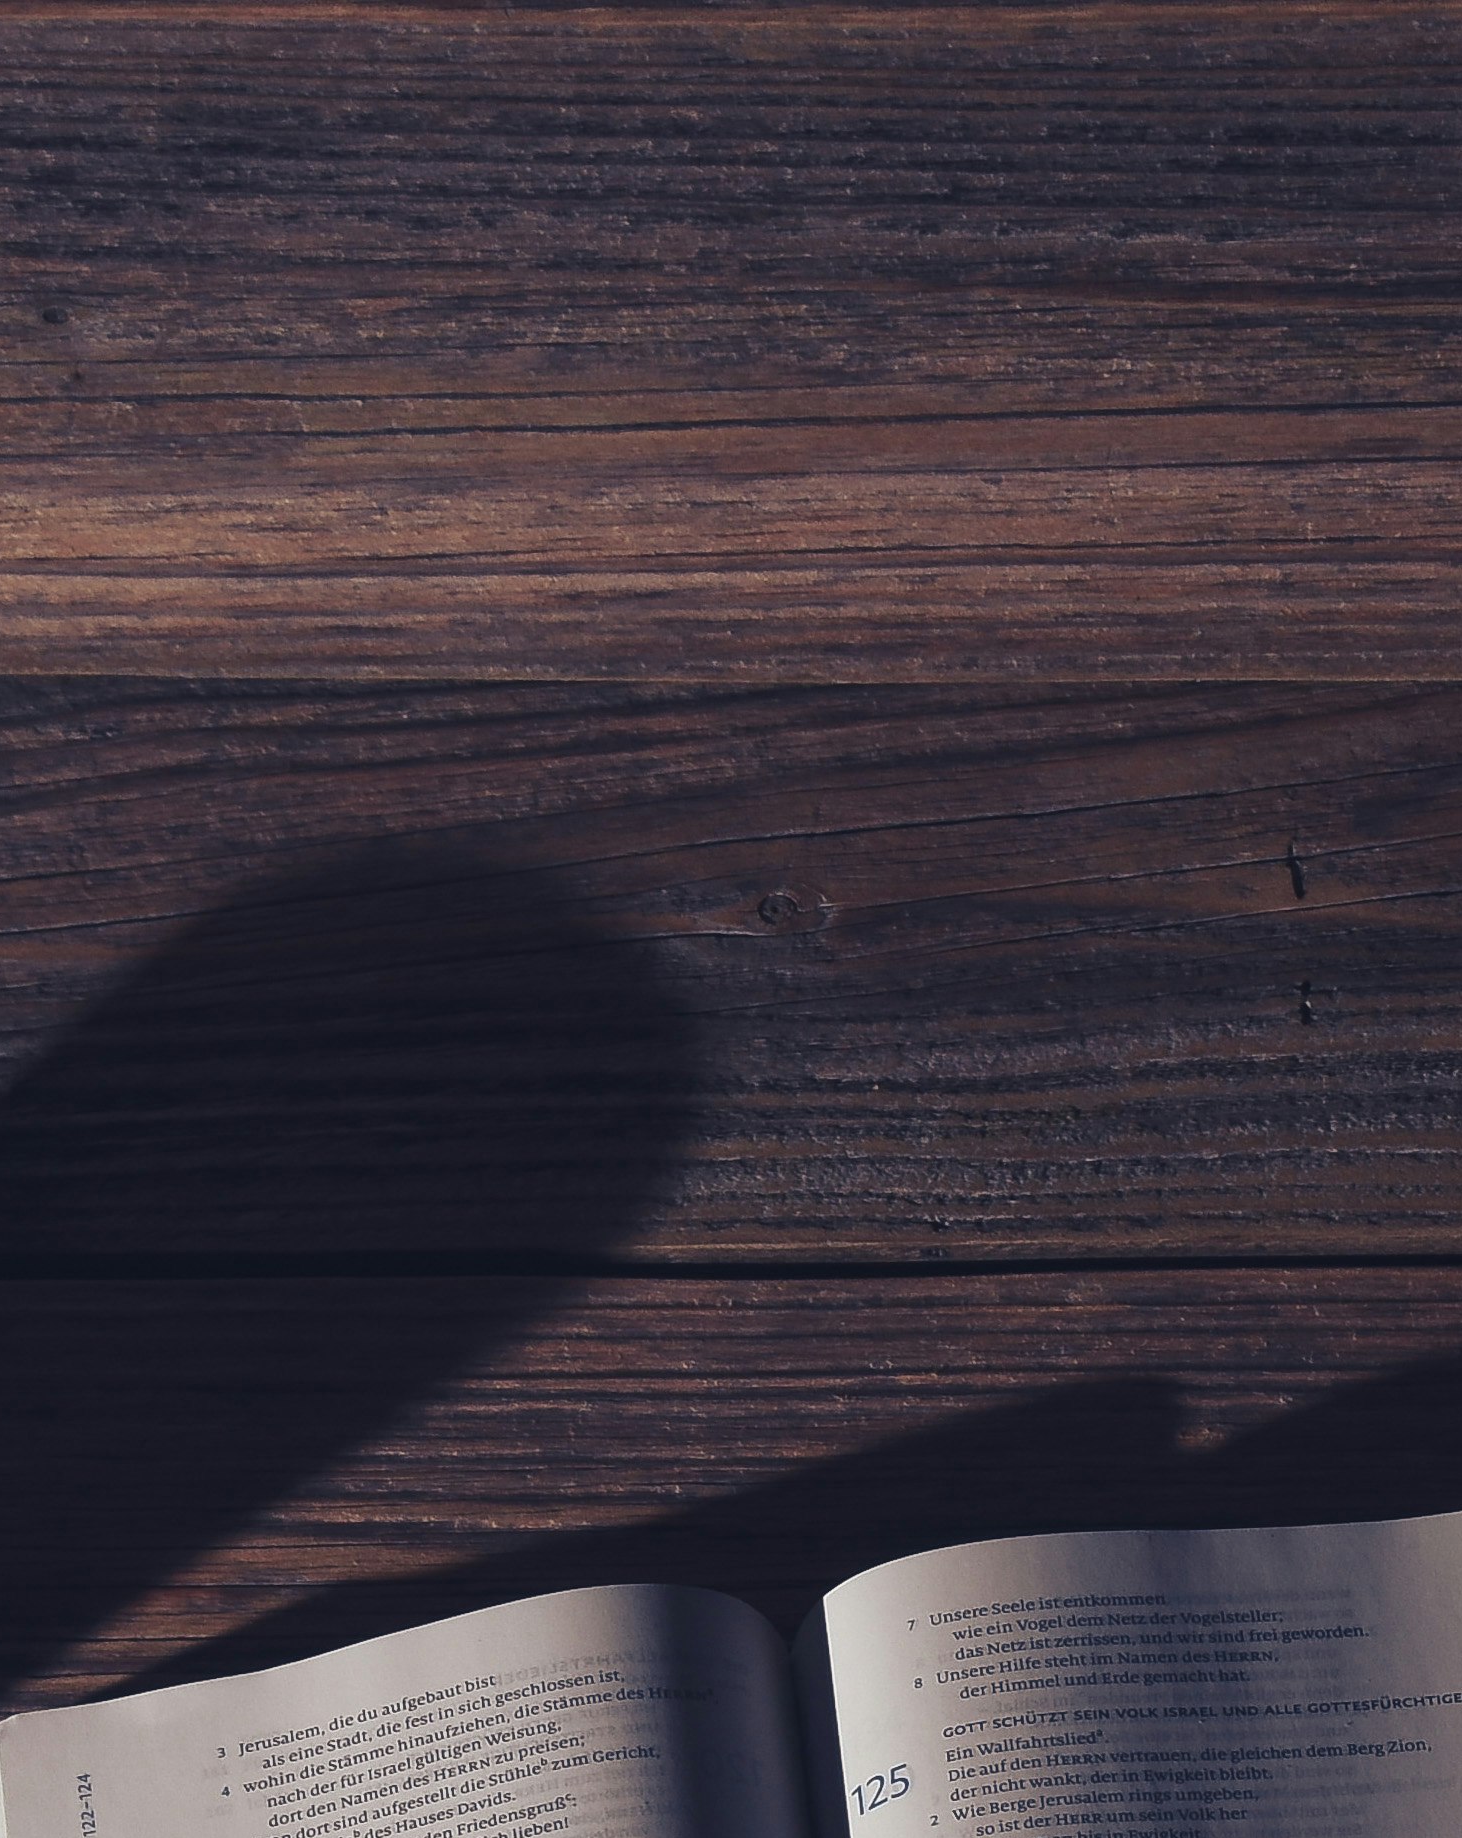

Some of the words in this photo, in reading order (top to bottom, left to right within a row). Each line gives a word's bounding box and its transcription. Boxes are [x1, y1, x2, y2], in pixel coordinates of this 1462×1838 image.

[950, 1623, 985, 1642] wie
[985, 1619, 1015, 1637] ein
[1014, 1613, 1067, 1634] Vogel
[1063, 1612, 1107, 1629] dem
[1105, 1612, 1150, 1627] Netz
[1147, 1611, 1178, 1626] der
[913, 1676, 924, 1690] 8
[935, 1664, 998, 1685] Unsere
[996, 1655, 1043, 1675] Hilfe
[1043, 1652, 1089, 1670] steht
[1089, 1651, 1115, 1667] im
[1115, 1650, 1180, 1666] Namen
[1180, 1649, 1212, 1665] des
[215, 1746, 227, 1760] 3
[237, 1725, 327, 1759] Jerusalem,
[328, 1714, 355, 1733] die
[355, 1708, 379, 1724] du
[380, 1683, 463, 1717] aufgebaut
[463, 1674, 498, 1694] bist
[261, 1753, 287, 1770] als
[287, 1744, 325, 1764] eine
[325, 1729, 374, 1753] Stadt,
[375, 1720, 403, 1739] die
[403, 1711, 436, 1731] fest
[436, 1706, 456, 1722] in
[456, 1695, 493, 1716] sich
[493, 1673, 597, 1709] geschlossen
[597, 1668, 626, 1684] ist,
[941, 1719, 989, 1739] GOTT
[991, 1709, 1070, 1730] SCHÜTZT
[1071, 1708, 1111, 1723] SEIN
[1113, 1706, 1160, 1720] VOLK
[1162, 1705, 1219, 1719] ISRAEL
[1221, 1704, 1261, 1719] UND
[1262, 1702, 1304, 1717] ALLE
[265, 1787, 308, 1809] nach
[309, 1779, 339, 1798] der
[339, 1771, 366, 1790] für
[366, 1755, 413, 1782] Israel
[414, 1739, 483, 1772] gültigen
[482, 1720, 563, 1747] Weisung,
[851, 1763, 910, 1816] 125
